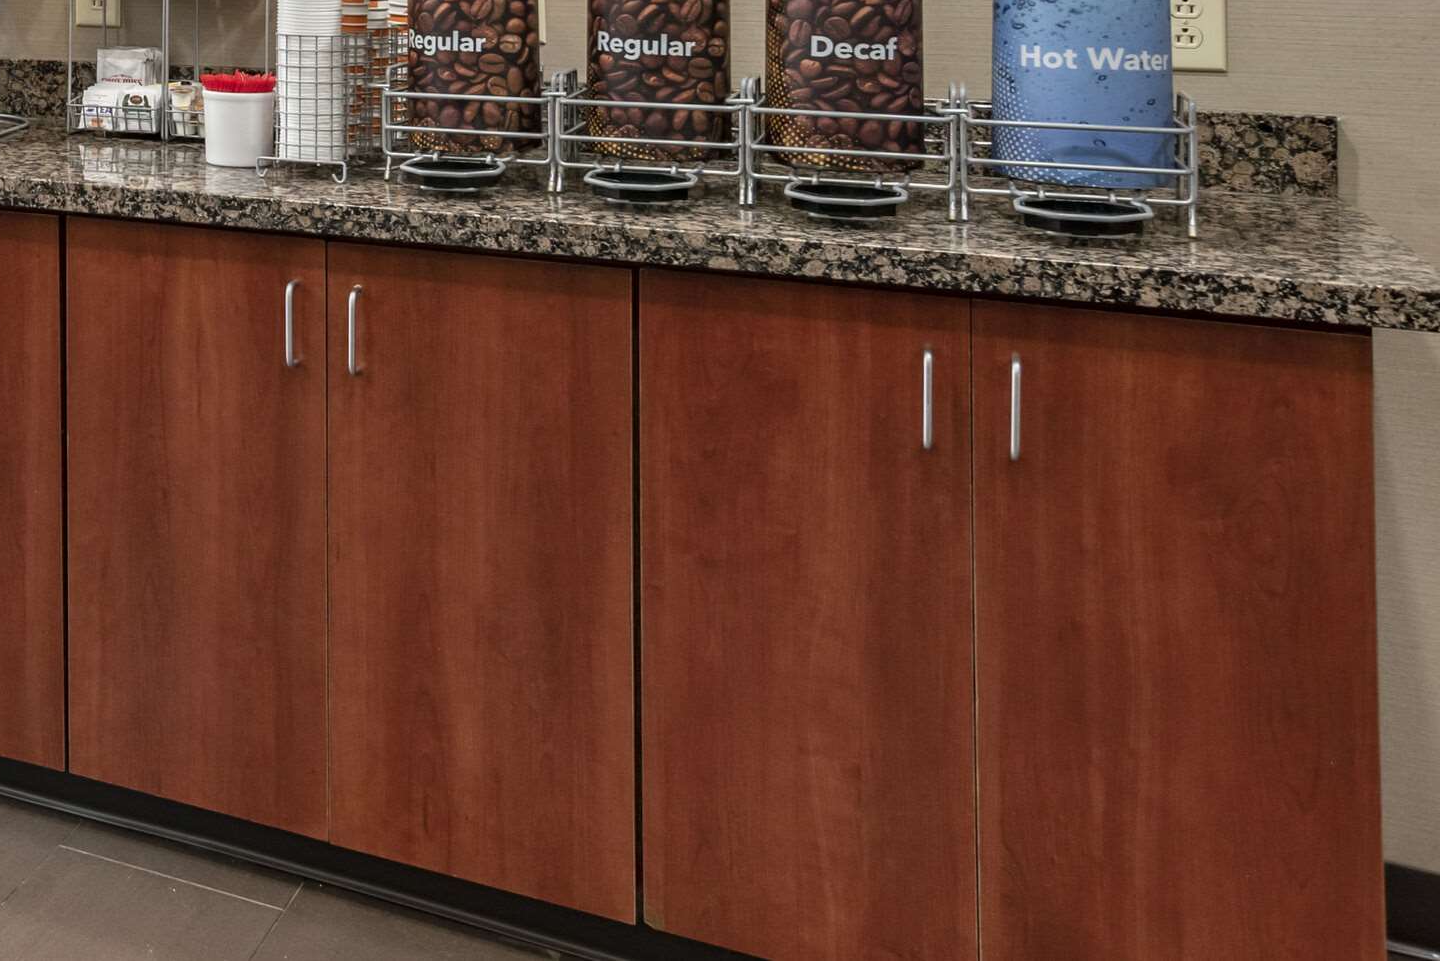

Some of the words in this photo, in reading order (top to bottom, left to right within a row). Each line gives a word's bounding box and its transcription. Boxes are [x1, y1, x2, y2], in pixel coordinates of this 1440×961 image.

[408, 28, 487, 56] Regular
[597, 30, 697, 60] Regular
[810, 35, 899, 60] Decaf
[1020, 44, 1078, 70] Hot
[1086, 46, 1169, 71] Water
